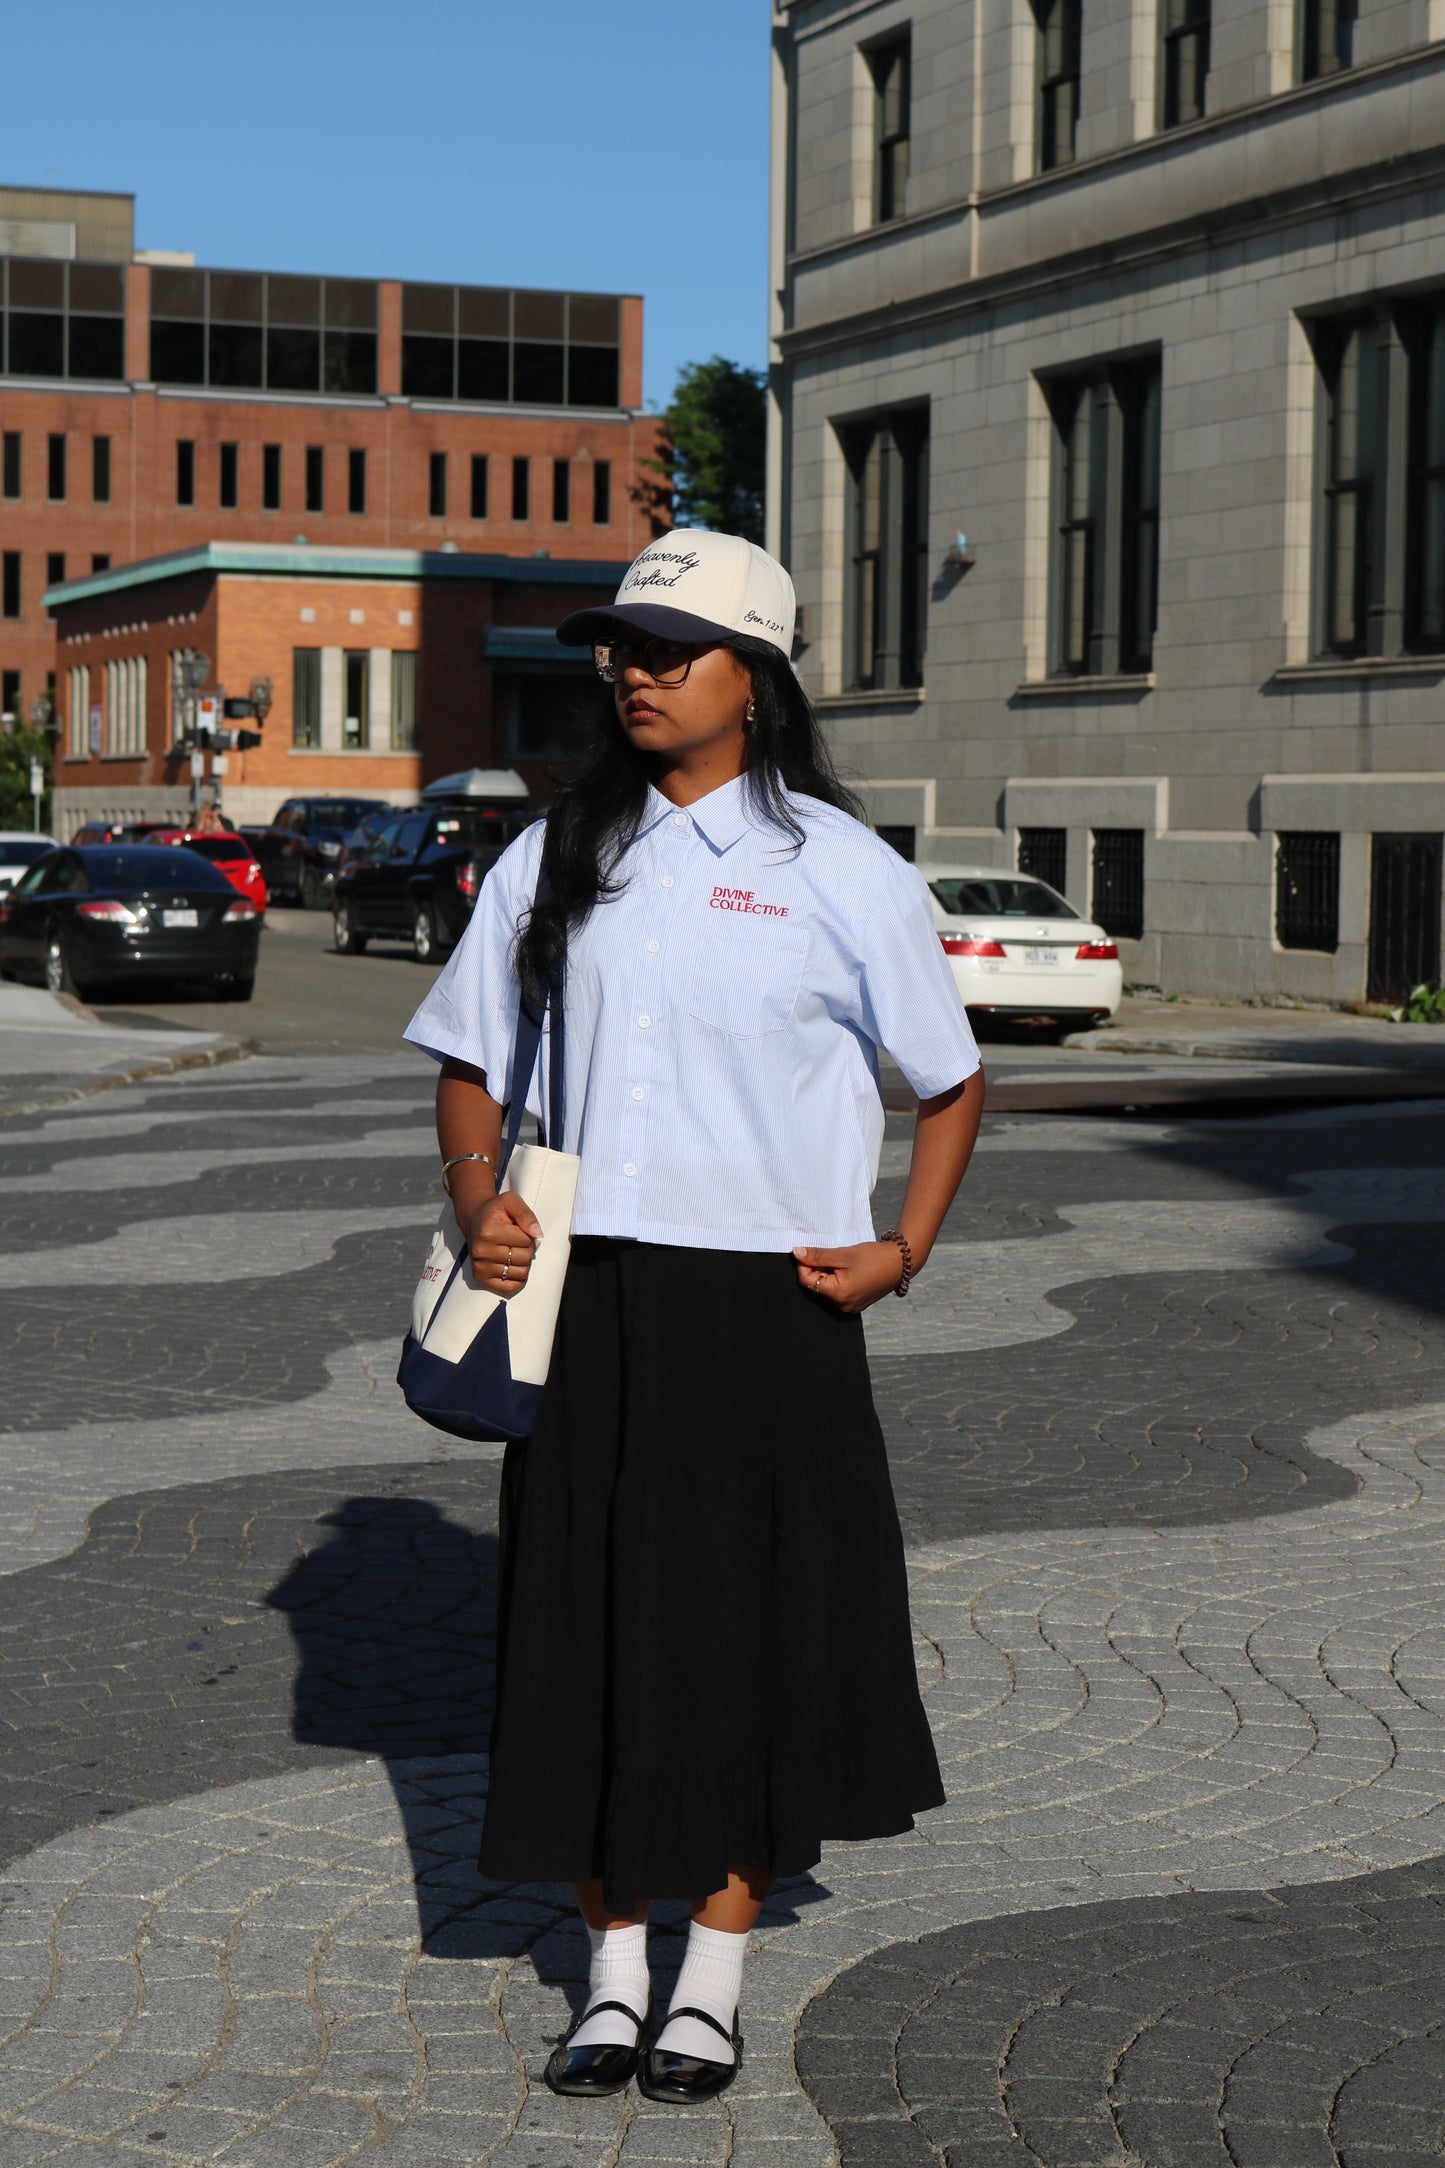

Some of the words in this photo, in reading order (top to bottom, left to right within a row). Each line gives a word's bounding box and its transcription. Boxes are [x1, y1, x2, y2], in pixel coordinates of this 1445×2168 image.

[631, 549, 700, 573] Heavenly
[625, 569, 682, 591] Crafted
[713, 886, 755, 902] DIVINE
[709, 898, 789, 916] COLLECTIVE
